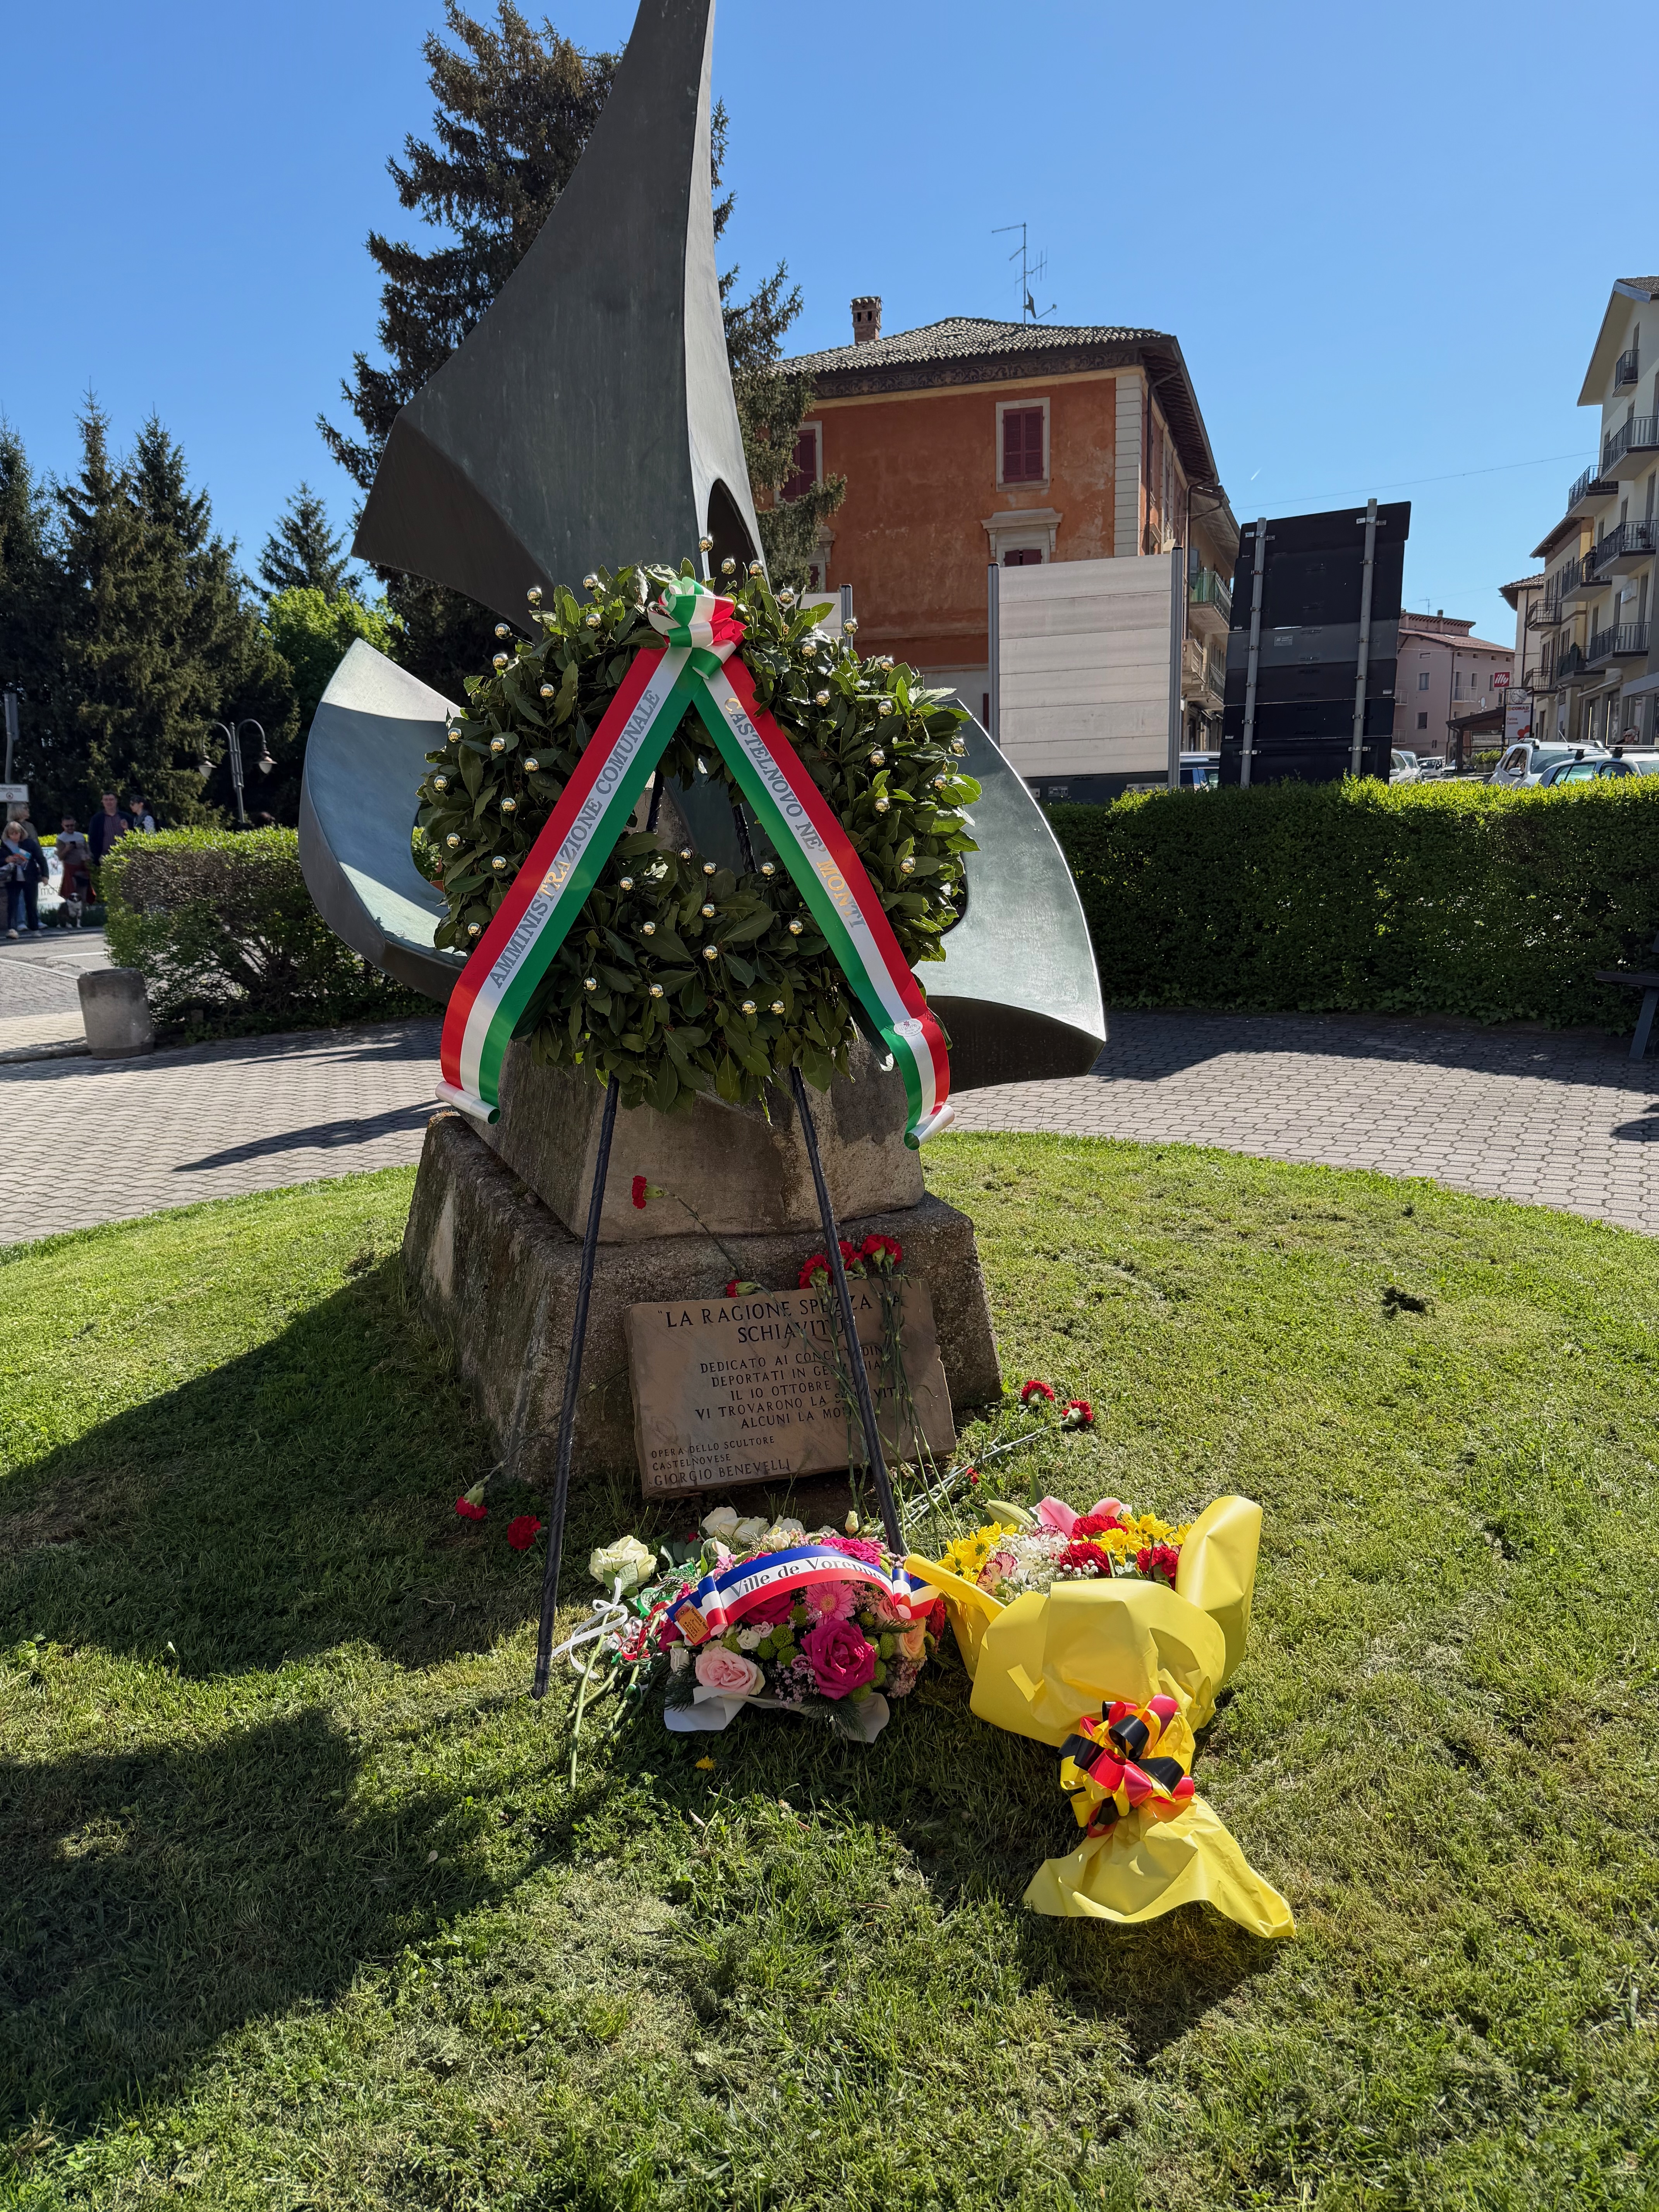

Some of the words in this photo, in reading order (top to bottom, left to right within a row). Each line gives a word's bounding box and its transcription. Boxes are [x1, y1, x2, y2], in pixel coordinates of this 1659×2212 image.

[1495, 674, 1509, 685] illy
[724, 697, 804, 817] CASTELNOVO
[816, 859, 866, 929] MONTI
[489, 797, 603, 989] AMMINISTRAZIONE
[596, 689, 660, 795] COMUNALE
[701, 1301, 792, 1324] RAGIONE
[700, 1357, 766, 1374] DEDICATO
[775, 1355, 788, 1366] AI
[711, 1370, 784, 1388] DEPORTATI
[792, 1367, 805, 1379] IN
[731, 1390, 742, 1401] IL
[772, 1381, 831, 1396] OTTOBRE
[696, 1408, 710, 1421] VI
[718, 1397, 802, 1417] TROVARONO
[811, 1395, 826, 1407] LA
[741, 1413, 790, 1429] ALCUNI
[798, 1411, 815, 1422] LA
[651, 1448, 684, 1458] OPERA
[689, 1443, 719, 1453] DELLO
[724, 1436, 775, 1449] SCULTORE
[653, 1454, 731, 1471] CASTELNOVESE
[654, 1469, 712, 1486] GIORGIO
[719, 1458, 791, 1477] BENEVELLI
[730, 1574, 770, 1597] Ville
[778, 1565, 800, 1578] de
